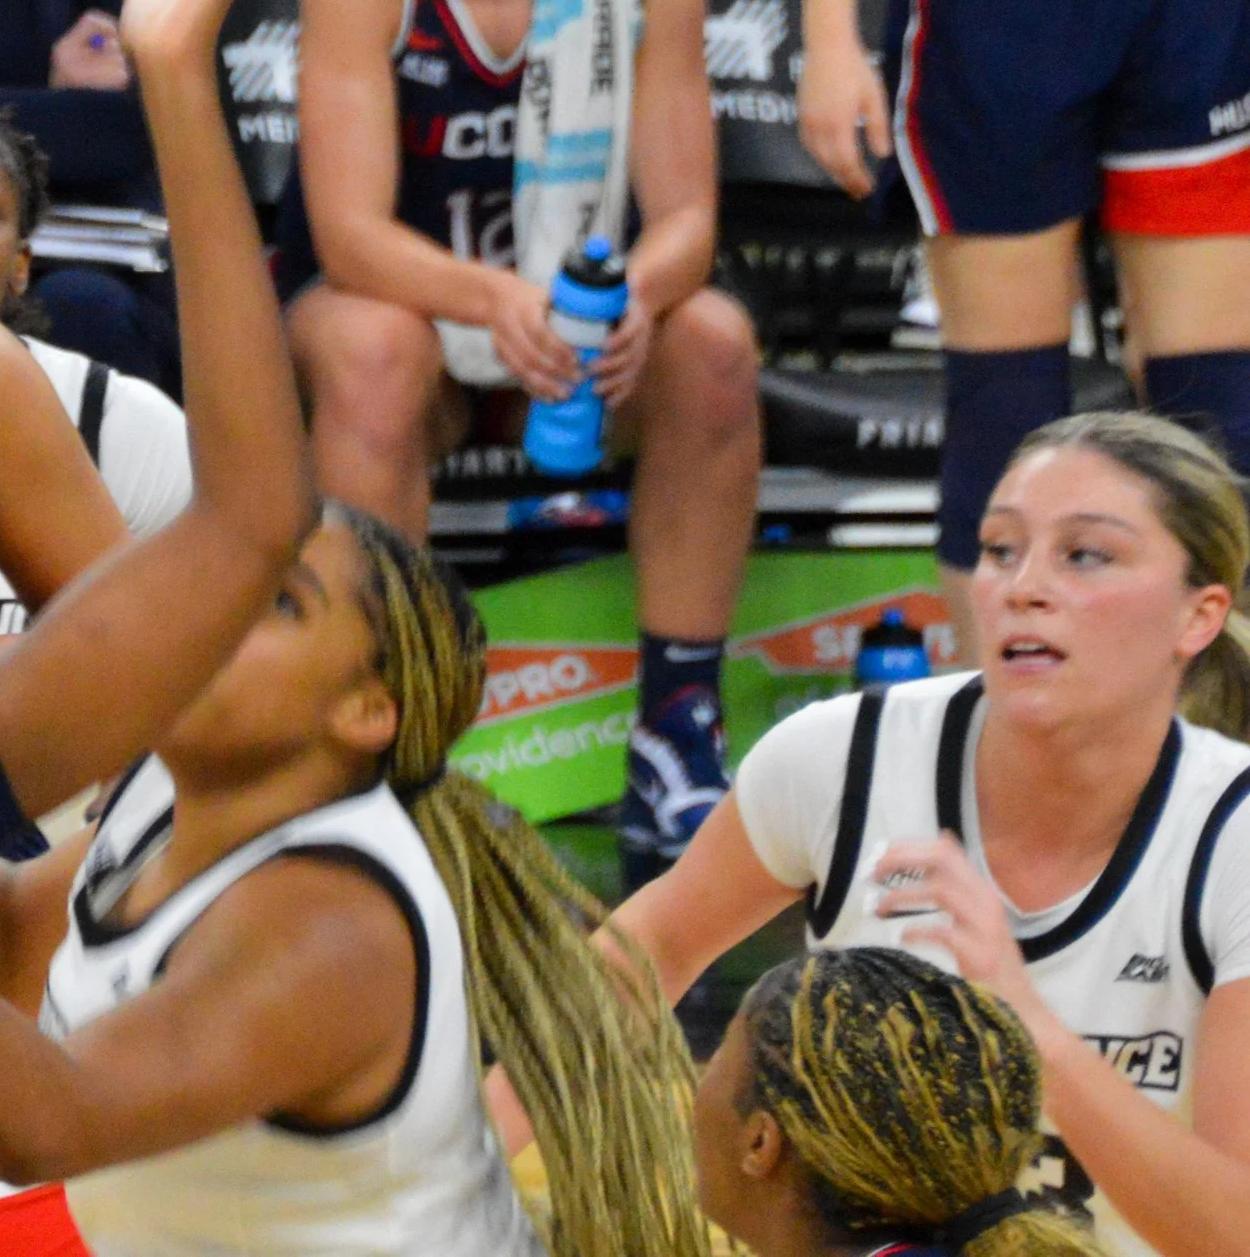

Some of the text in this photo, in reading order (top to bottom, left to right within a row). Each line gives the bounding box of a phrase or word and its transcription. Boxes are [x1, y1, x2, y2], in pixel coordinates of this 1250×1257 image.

[405, 104, 518, 160] UCO
[711, 90, 797, 125] MEDI
[450, 710, 638, 782] ovidenc
